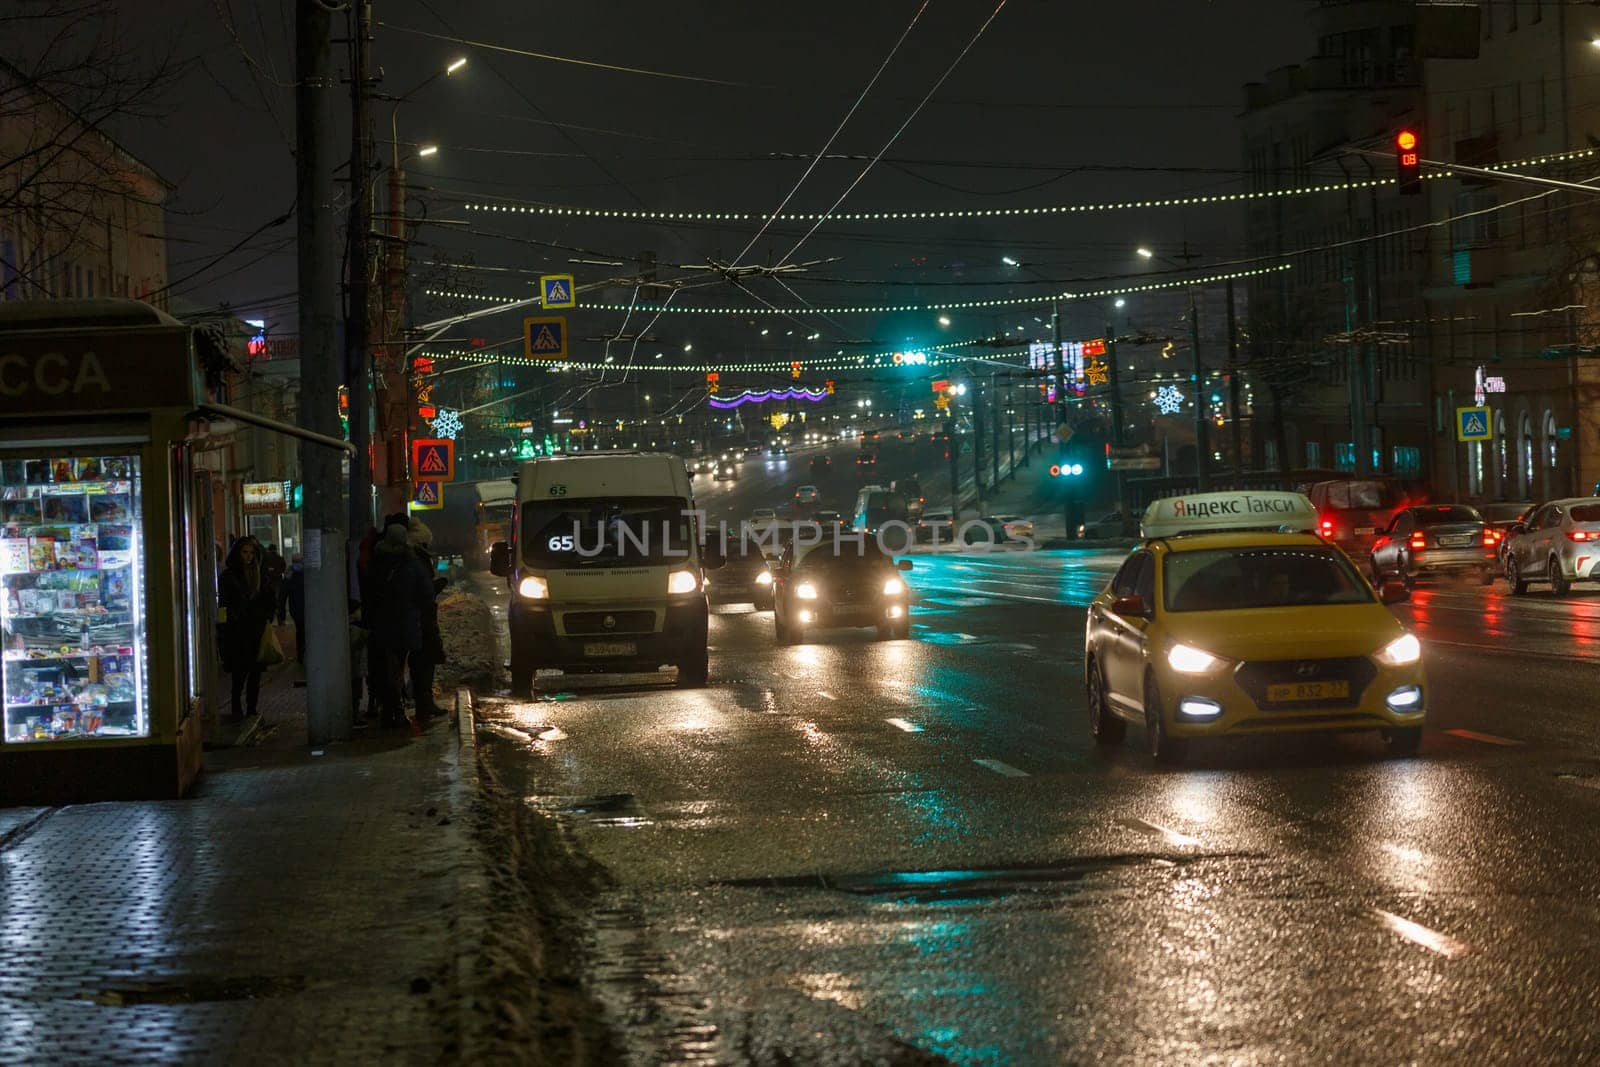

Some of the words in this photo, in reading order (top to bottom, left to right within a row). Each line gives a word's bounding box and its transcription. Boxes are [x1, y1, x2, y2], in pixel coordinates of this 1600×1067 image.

[550, 486, 567, 495] 65
[1174, 499, 1240, 517] Яндекс
[1242, 496, 1295, 513] Такси
[548, 536, 574, 551] 65
